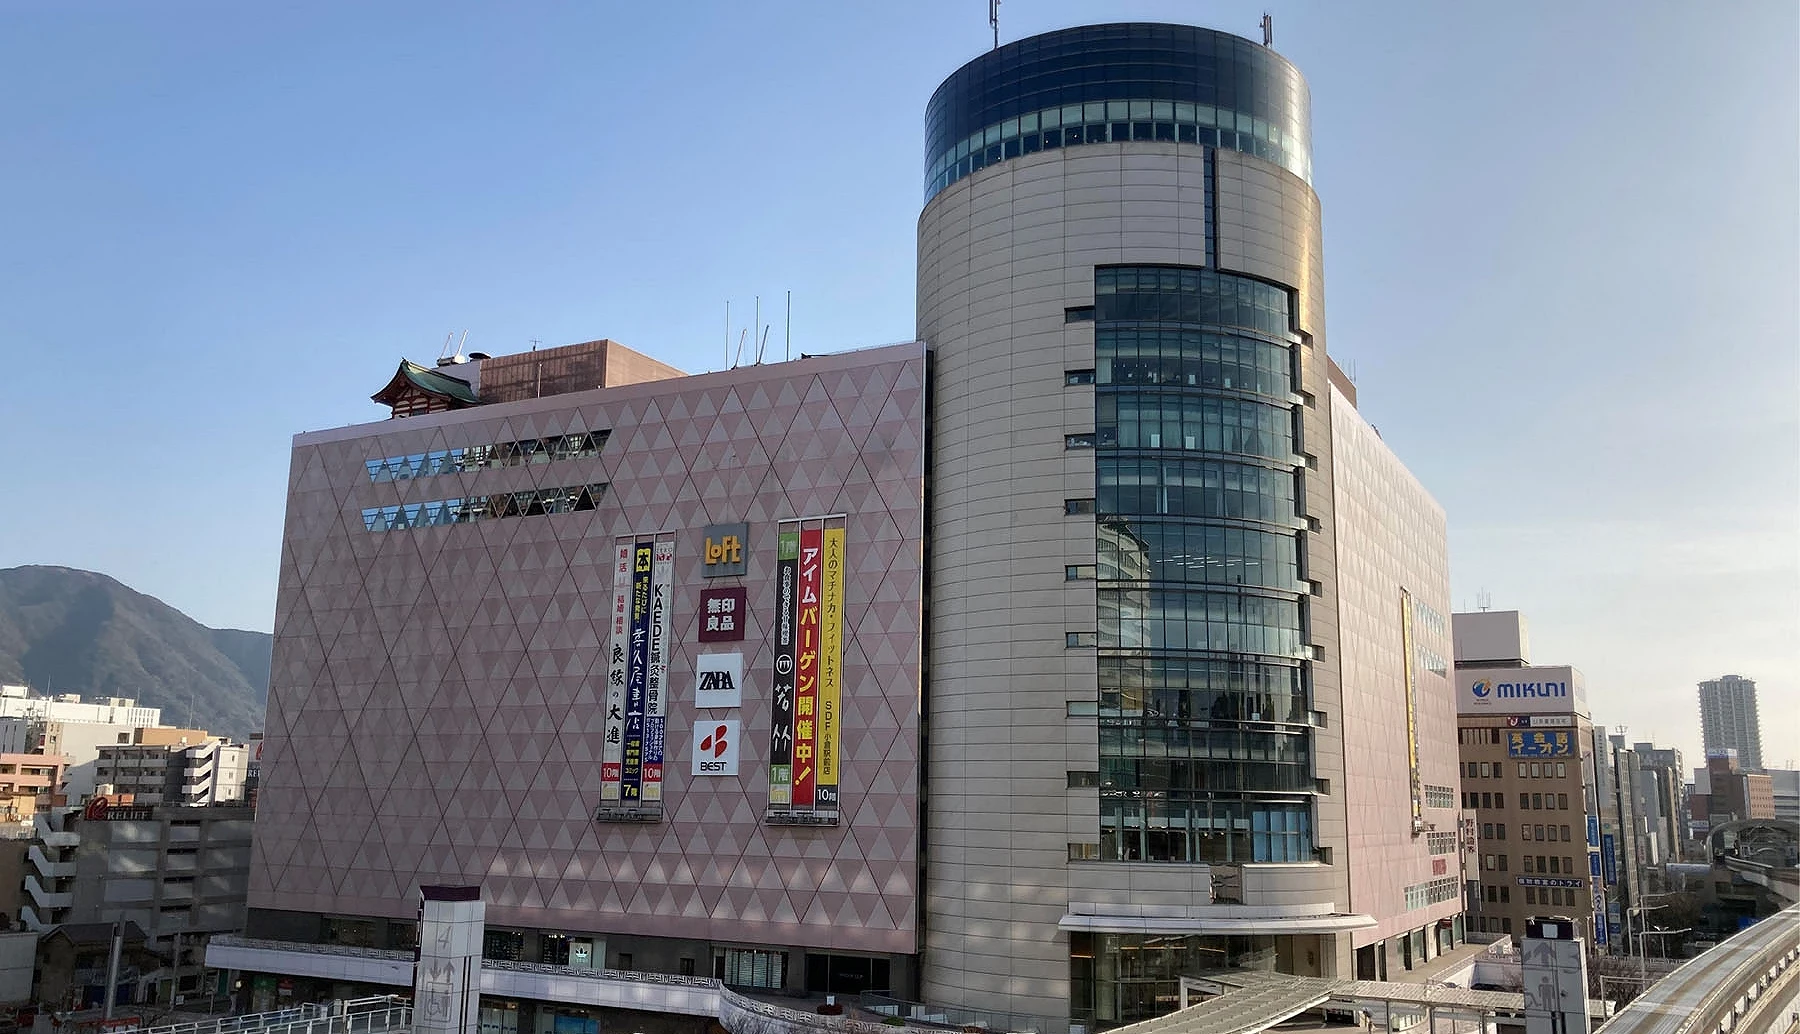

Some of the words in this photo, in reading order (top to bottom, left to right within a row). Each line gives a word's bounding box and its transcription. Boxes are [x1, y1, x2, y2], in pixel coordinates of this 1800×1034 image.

[637, 552, 649, 570] 本
[707, 598, 735, 613] 無印
[706, 616, 734, 631] 良品
[699, 671, 735, 690] ZARA
[1511, 743, 1568, 754] イーオン
[603, 767, 619, 778] 10階
[644, 767, 661, 779] 10階
[700, 762, 727, 771] BEST
[772, 766, 789, 782] 1階
[623, 784, 638, 797] 7階
[818, 789, 837, 801] 10階
